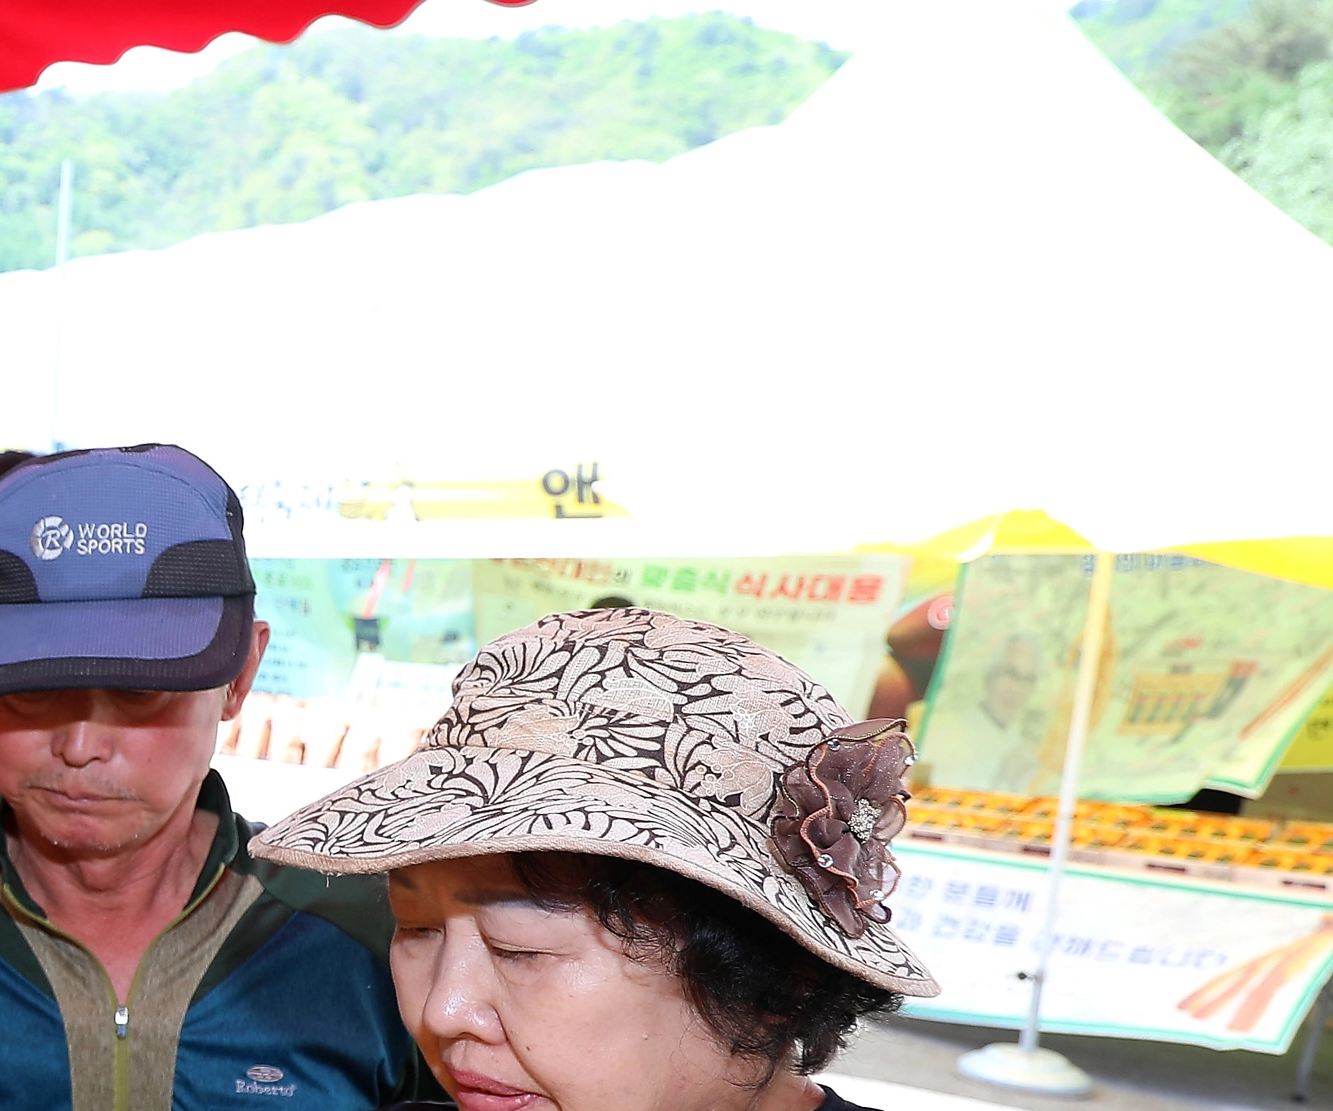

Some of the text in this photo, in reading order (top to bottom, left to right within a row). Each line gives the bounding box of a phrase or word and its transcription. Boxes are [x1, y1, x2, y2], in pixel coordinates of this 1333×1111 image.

[77, 522, 148, 539] WORLD
[76, 538, 146, 556] SPORTS
[733, 572, 885, 603] 식사대용
